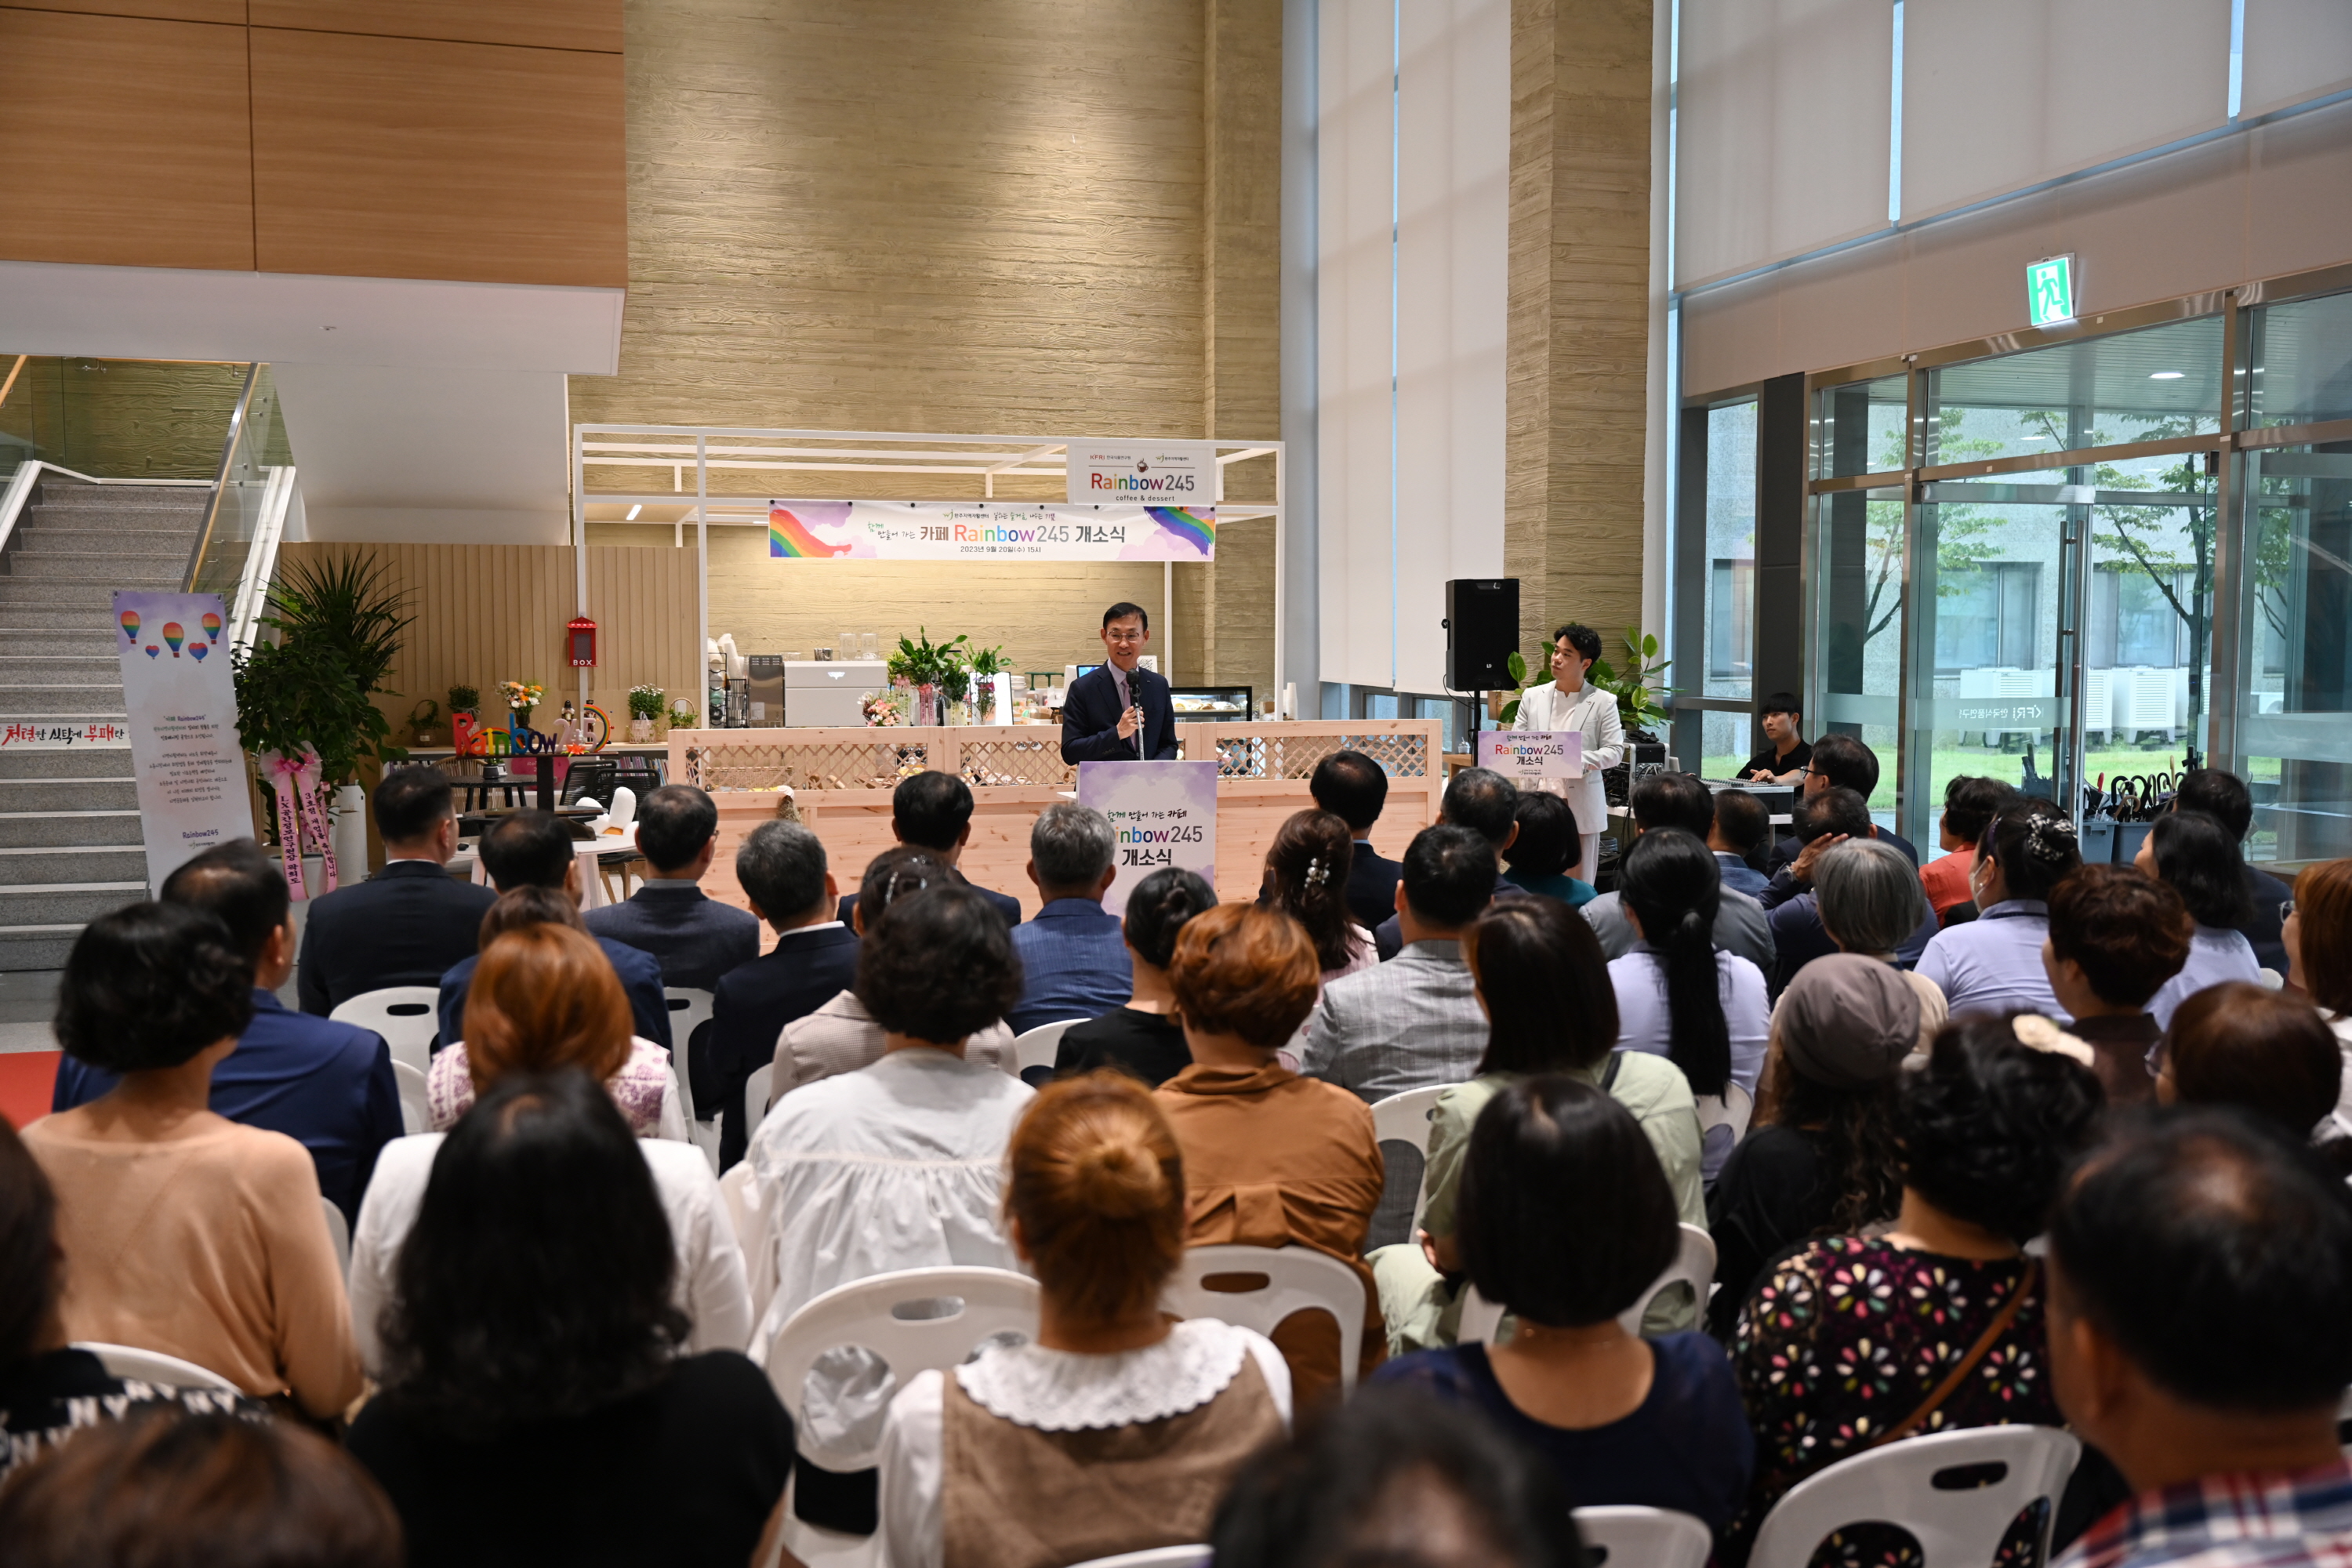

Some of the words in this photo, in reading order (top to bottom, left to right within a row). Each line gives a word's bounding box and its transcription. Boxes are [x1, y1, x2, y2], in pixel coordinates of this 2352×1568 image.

[1091, 473, 1195, 492] Rainbow245
[867, 521, 884, 532] 함께
[920, 525, 949, 542] 카페
[954, 524, 1069, 543] Rainbow245
[1075, 525, 1126, 543] 개소식
[877, 530, 898, 541] 만들어
[902, 530, 916, 539] 가는
[2, 724, 47, 746] 청렴한
[49, 728, 82, 745] 식탁에
[84, 724, 125, 742] 부패란
[1495, 744, 1564, 755] Rainbow245
[1516, 756, 1543, 765] 개소식
[305, 792, 316, 814] 3호점
[1107, 809, 1126, 822] 함께
[1129, 811, 1149, 822] 만들어
[1151, 811, 1165, 820] 가는
[1167, 809, 1187, 819] 카페
[182, 829, 219, 839] Rainbow245
[310, 818, 325, 839] 개업을
[1122, 848, 1172, 866] 개소식
